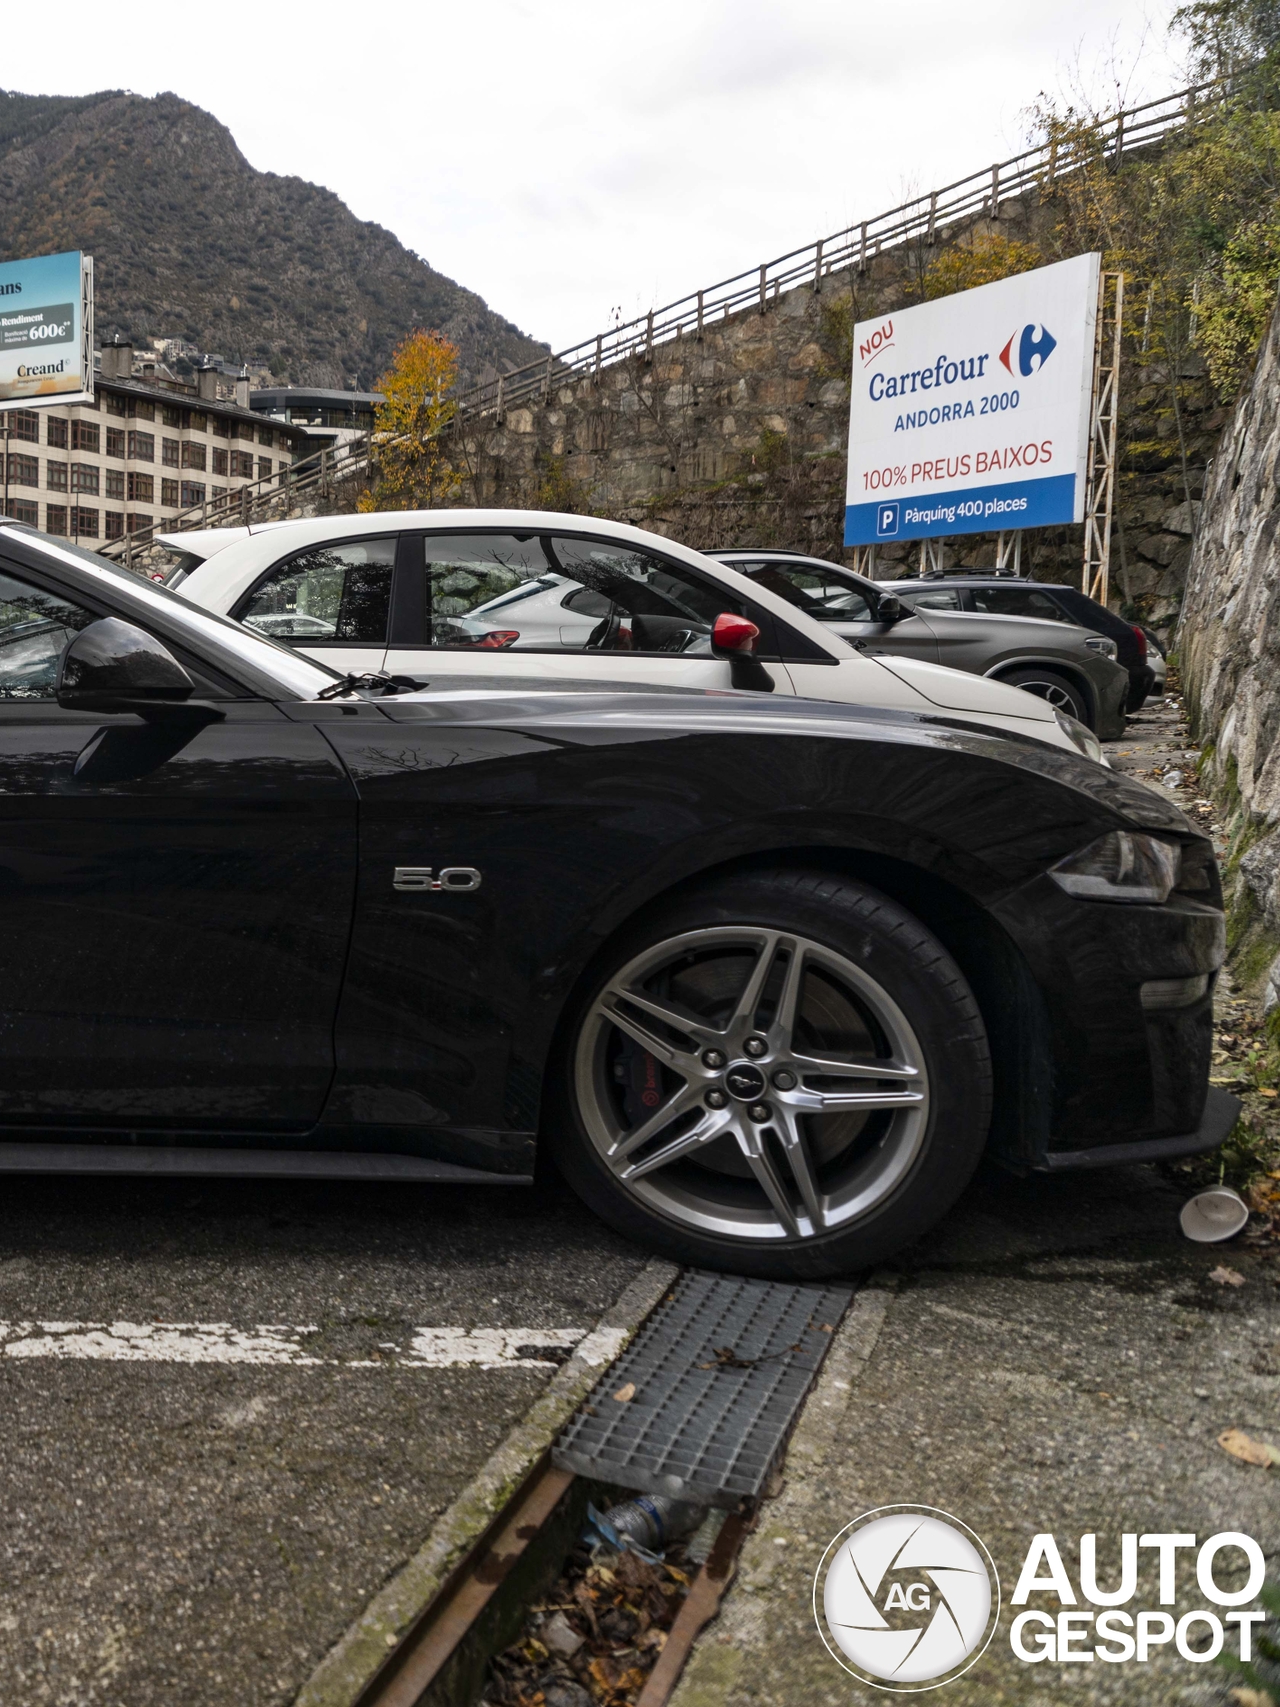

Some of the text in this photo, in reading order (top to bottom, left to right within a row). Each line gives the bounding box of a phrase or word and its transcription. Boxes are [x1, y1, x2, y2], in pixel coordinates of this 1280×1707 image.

[1, 313, 44, 327] Rendiment
[859, 320, 894, 361] NOU
[17, 359, 64, 378] Creand
[869, 353, 989, 402] Carrefour
[894, 390, 1020, 432] ANDORRA 2000
[863, 440, 1053, 490] 100% PREUS BAIXOS
[905, 505, 956, 525] Pàrquing
[957, 500, 983, 514] 400
[985, 497, 1028, 518] places
[393, 866, 482, 891] 5.0
